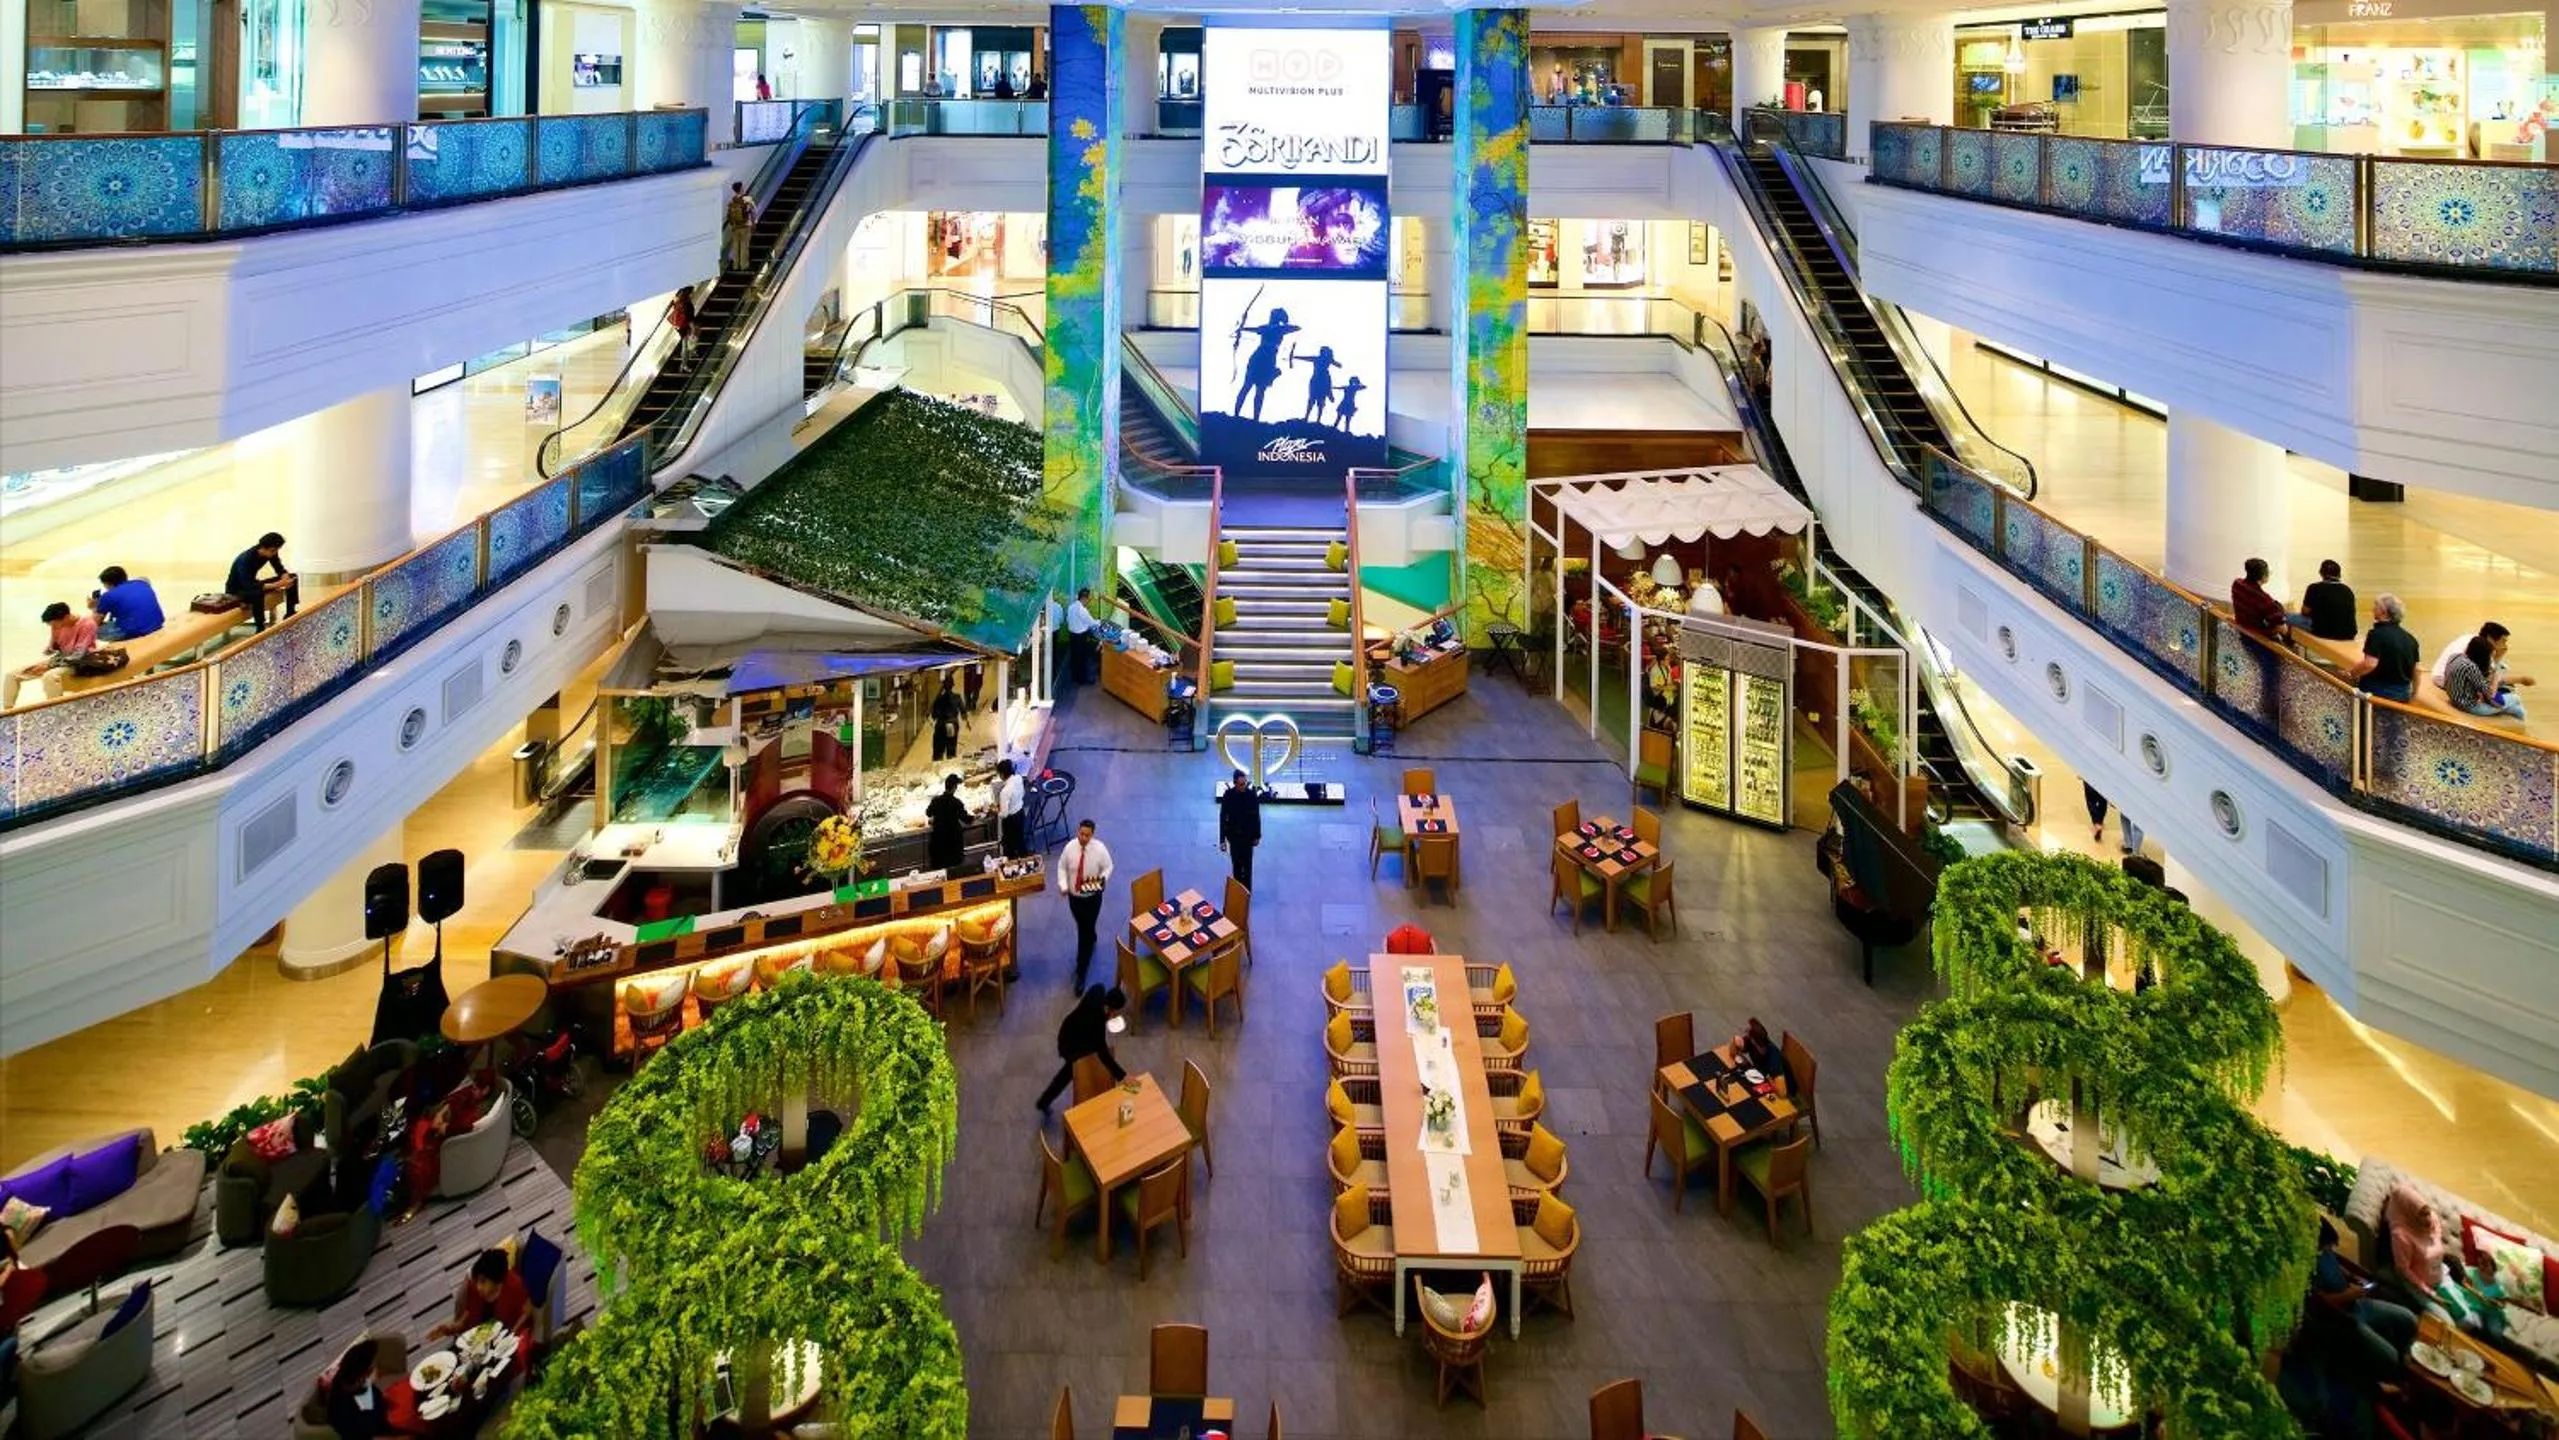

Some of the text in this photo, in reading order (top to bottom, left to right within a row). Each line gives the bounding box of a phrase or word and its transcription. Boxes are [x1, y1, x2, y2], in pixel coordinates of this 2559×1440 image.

[2348, 3, 2393, 17] FRANZ
[1248, 86, 1344, 96] MULTIVISION PLUS
[1258, 452, 1326, 462] INDONESIA
